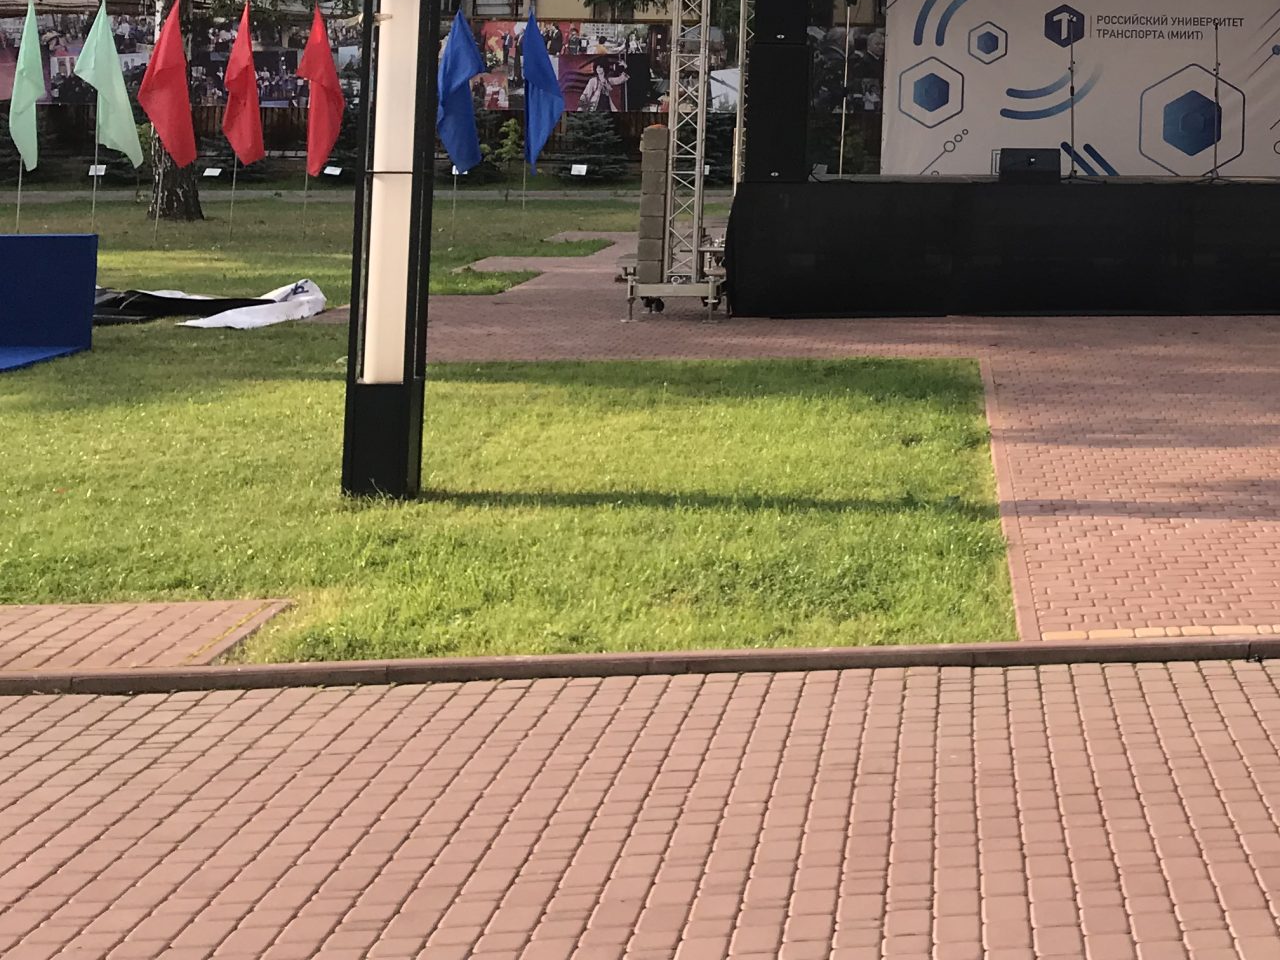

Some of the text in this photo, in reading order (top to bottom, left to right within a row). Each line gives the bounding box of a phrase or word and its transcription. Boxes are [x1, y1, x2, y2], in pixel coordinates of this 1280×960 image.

[1096, 13, 1244, 27] РОССИЙСКИЙ УНИВЕРСИТЕТ
[1096, 28, 1203, 41] ТРАНСПОРТА (МИИТ)
